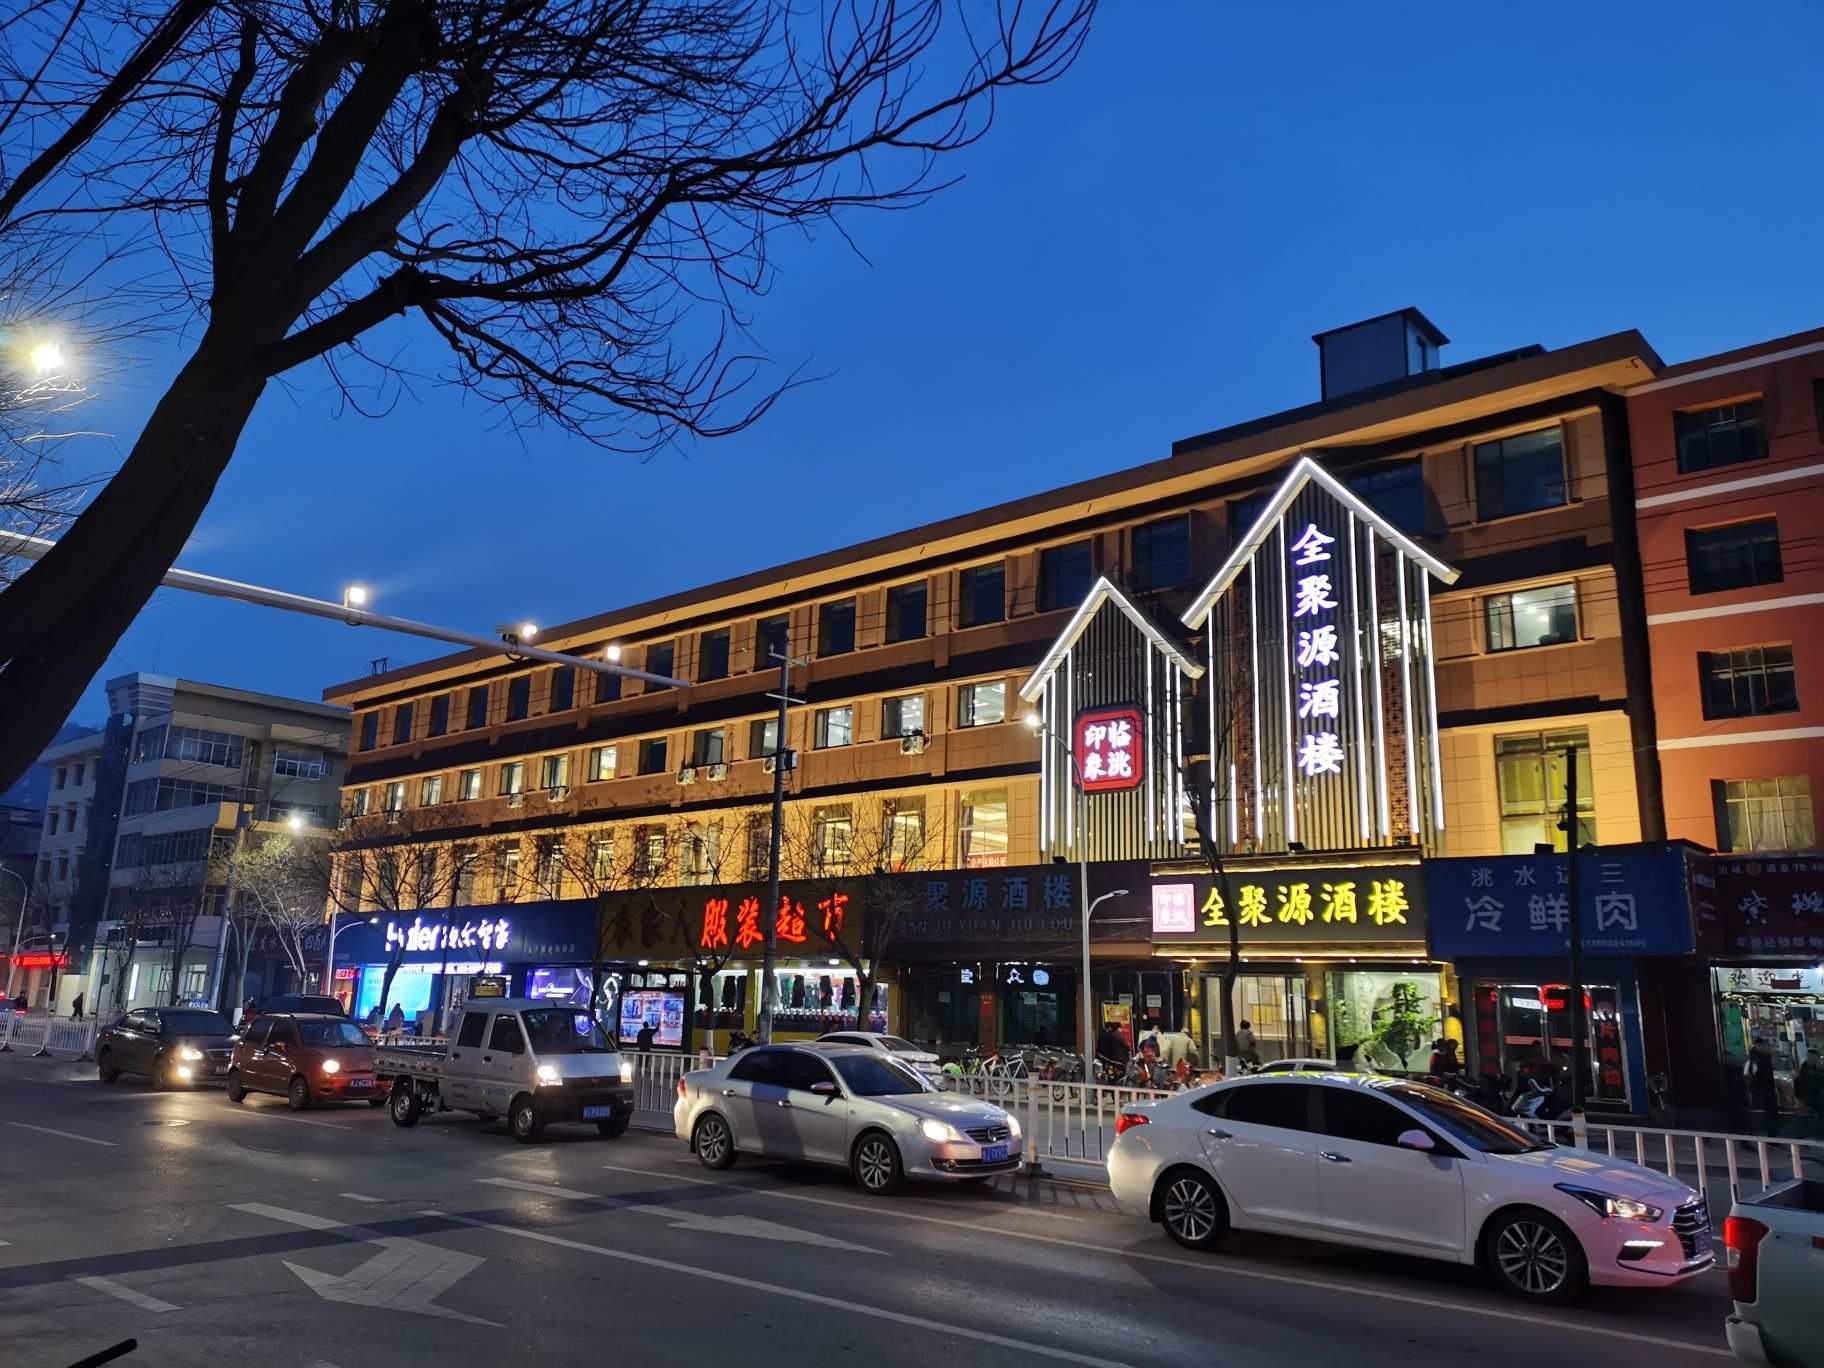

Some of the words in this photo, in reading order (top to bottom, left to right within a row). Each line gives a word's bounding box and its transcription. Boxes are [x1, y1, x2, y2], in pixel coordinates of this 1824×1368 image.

[1291, 523, 1345, 777] 全聚源酒楼
[892, 874, 1072, 912] 聚源酒楼
[1200, 879, 1410, 928] 全聚源酒楼
[1463, 891, 1639, 933] 冷鲜肉
[890, 921, 928, 934] UAN
[959, 919, 1000, 931] YUAN
[1041, 917, 1073, 931] LOU
